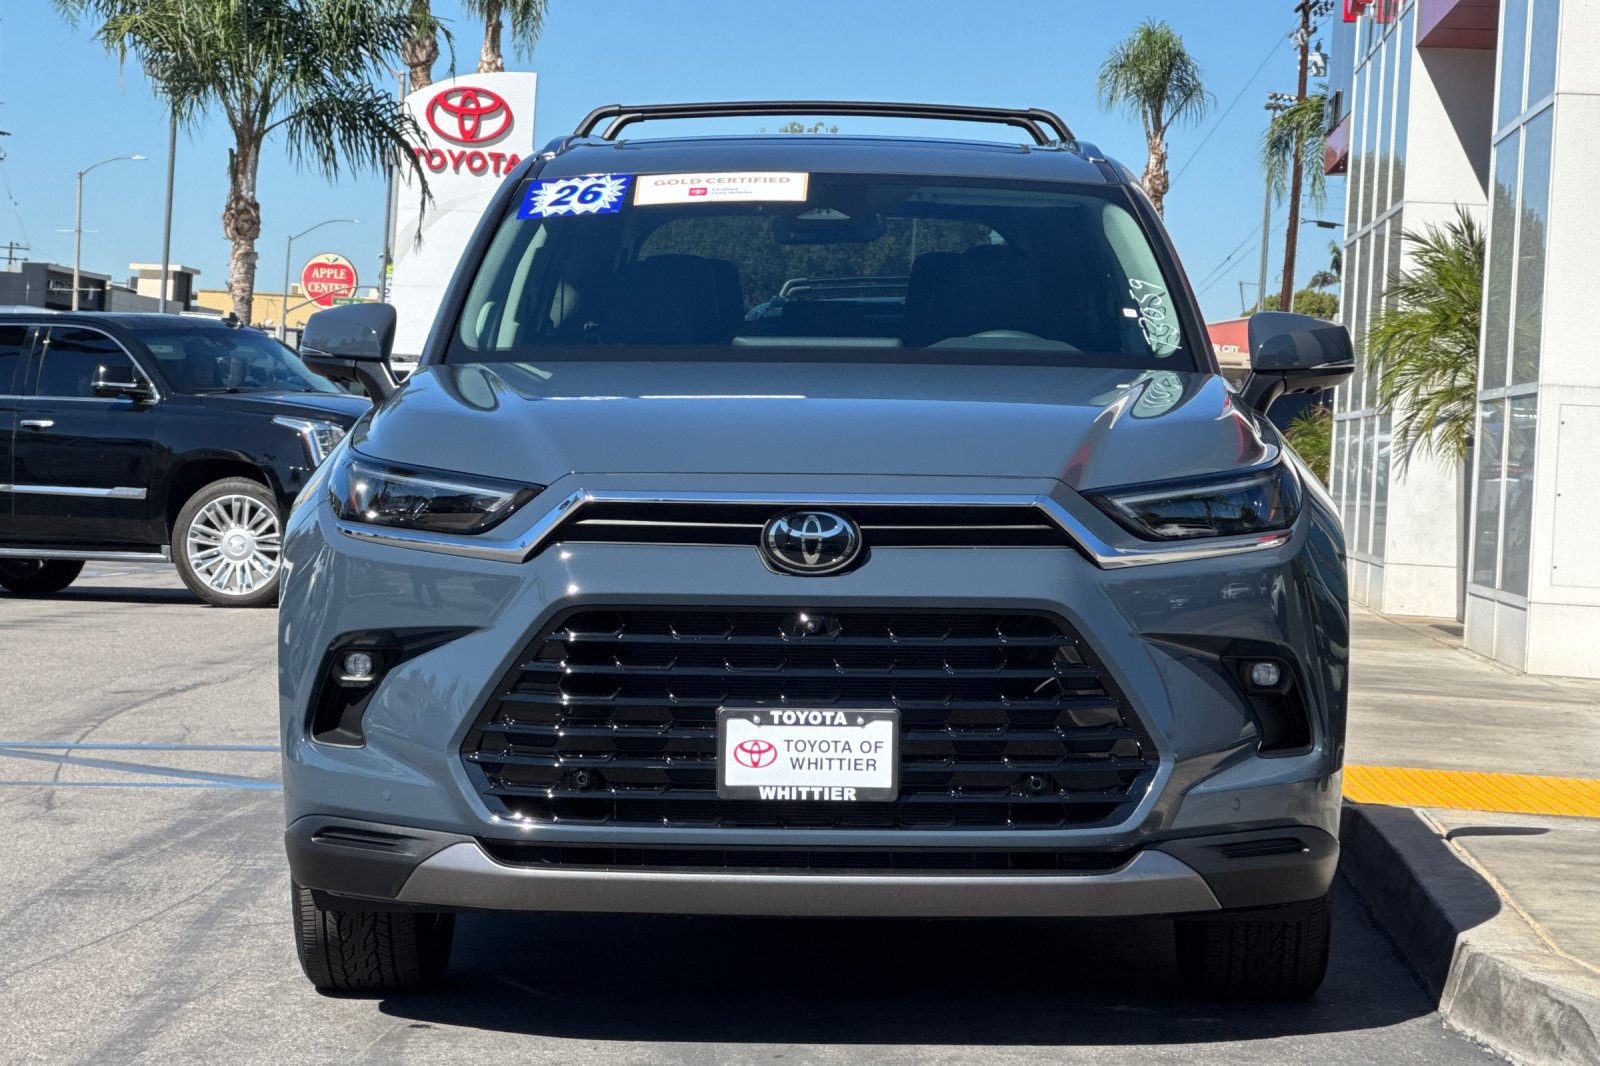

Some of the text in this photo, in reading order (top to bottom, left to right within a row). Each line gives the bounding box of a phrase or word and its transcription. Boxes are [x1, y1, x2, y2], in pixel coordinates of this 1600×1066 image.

[653, 176, 791, 187] GOLD CERTIFIED
[550, 182, 606, 207] 26
[311, 267, 347, 280] APPLE
[307, 281, 349, 295] CENTER
[1222, 345, 1240, 353] CITY
[770, 710, 848, 726] TOYOTA
[784, 739, 884, 754] TOYOTA OF
[790, 757, 877, 772] WHITTIER
[758, 785, 857, 801] WHITTIER
